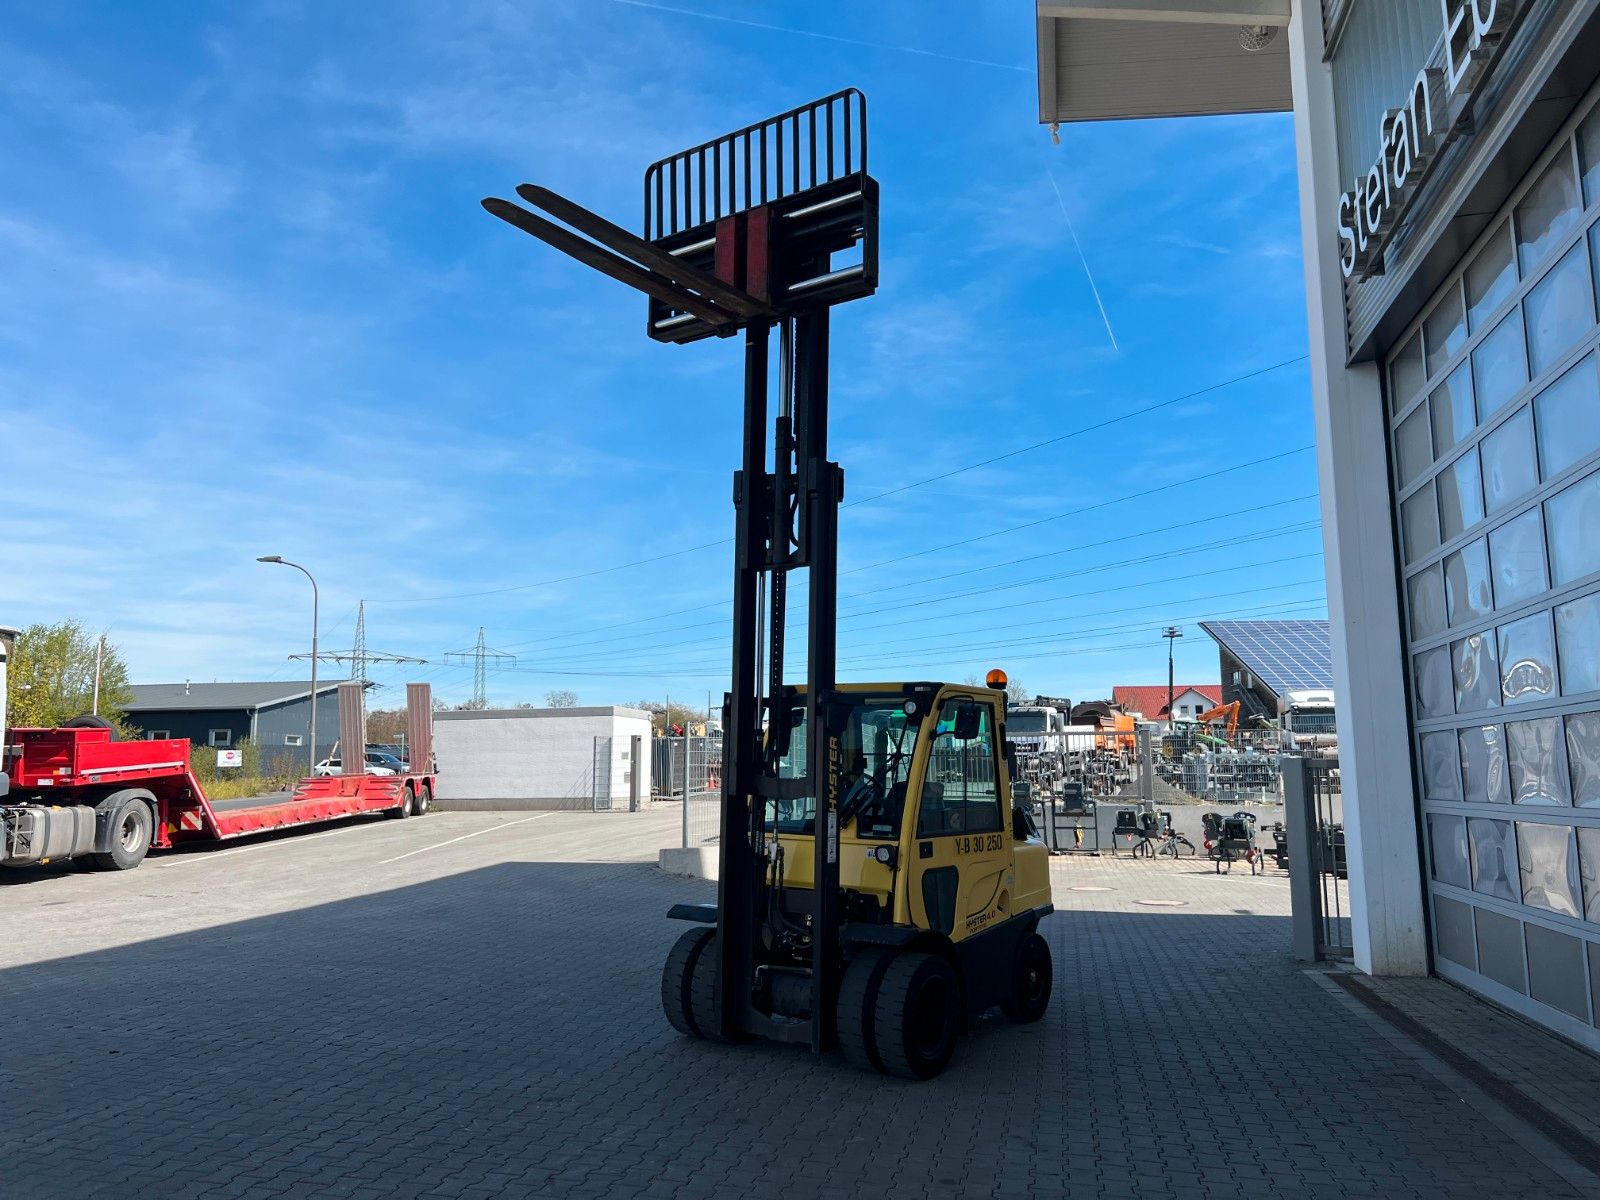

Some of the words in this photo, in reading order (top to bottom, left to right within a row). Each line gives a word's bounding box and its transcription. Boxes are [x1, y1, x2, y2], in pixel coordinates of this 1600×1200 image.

[1337, 68, 1432, 278] Stefan
[828, 736, 838, 812] HYSTER
[955, 837, 970, 855] Y-B
[973, 836, 984, 853] 30
[987, 834, 1002, 851] 250
[965, 914, 986, 929] HYSTER
